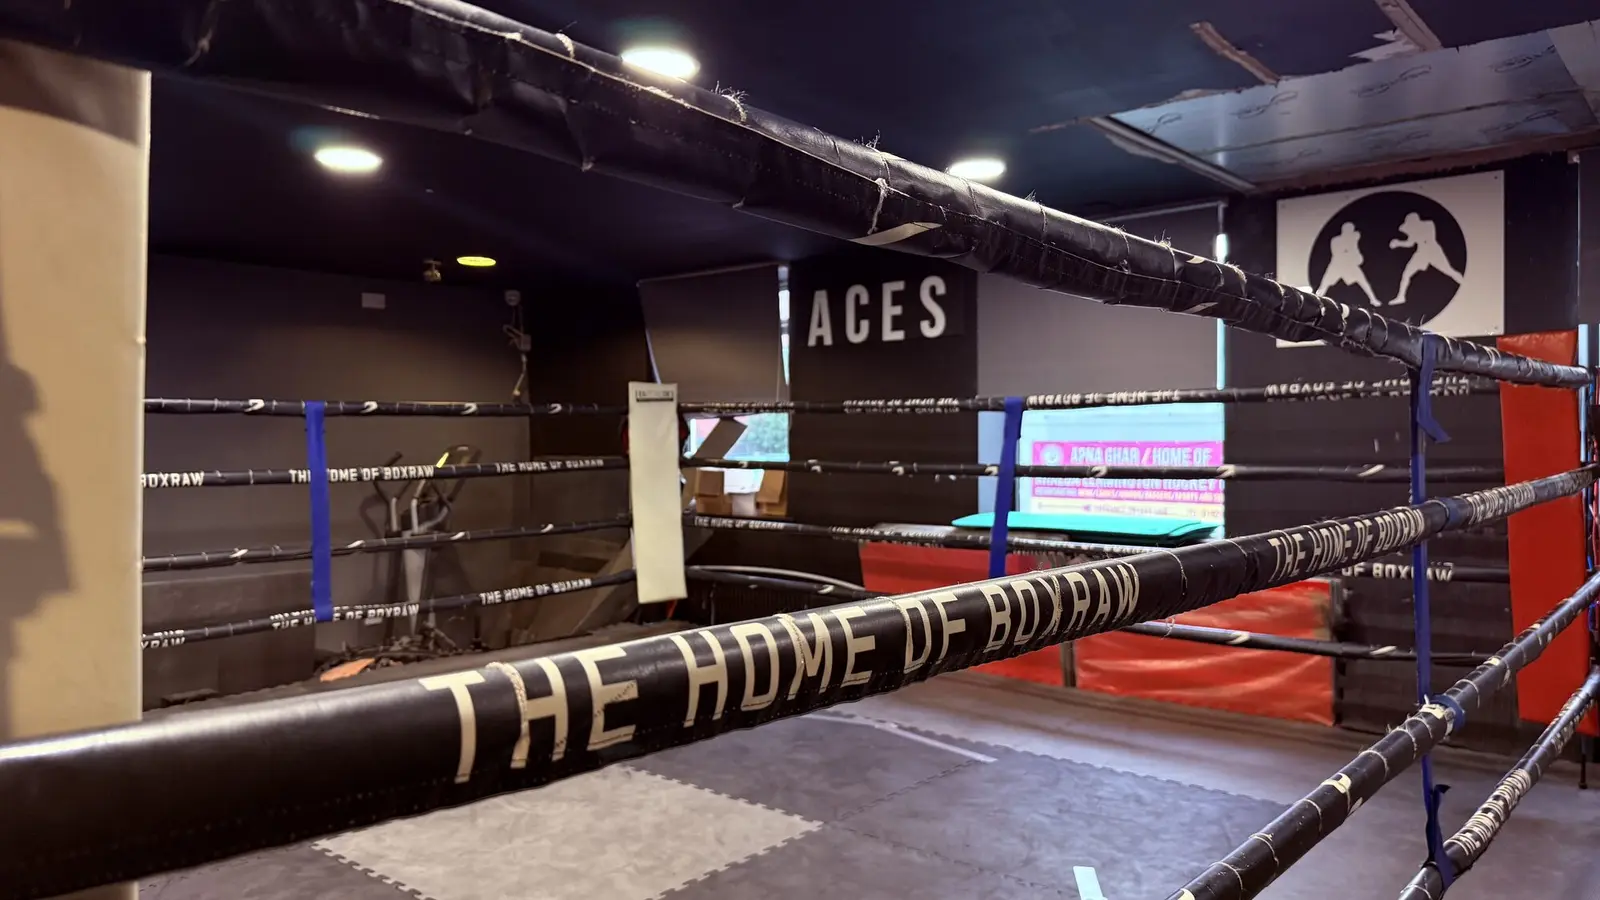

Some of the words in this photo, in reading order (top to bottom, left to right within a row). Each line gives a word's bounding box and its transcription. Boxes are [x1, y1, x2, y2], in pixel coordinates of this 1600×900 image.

[807, 275, 946, 347] ACES
[1071, 447, 1103, 465] APNA
[1105, 447, 1140, 466] GHAR
[1153, 447, 1192, 466] HOME
[1193, 447, 1213, 466] OF
[288, 469, 311, 483] TH
[327, 468, 357, 482] OME
[361, 467, 380, 480] OF
[382, 465, 434, 479] BOXRAW
[1268, 533, 1306, 583] THE
[1307, 523, 1351, 573] HOME
[1352, 519, 1374, 560] OF
[1373, 508, 1425, 553] BOXRAW
[1373, 562, 1453, 580] BOXAW
[479, 592, 501, 605] THE
[504, 586, 534, 600] HOME
[419, 644, 639, 784] THE
[669, 606, 876, 728] HOME
[893, 592, 967, 674] OF
[978, 562, 1140, 653] BOXRAW
